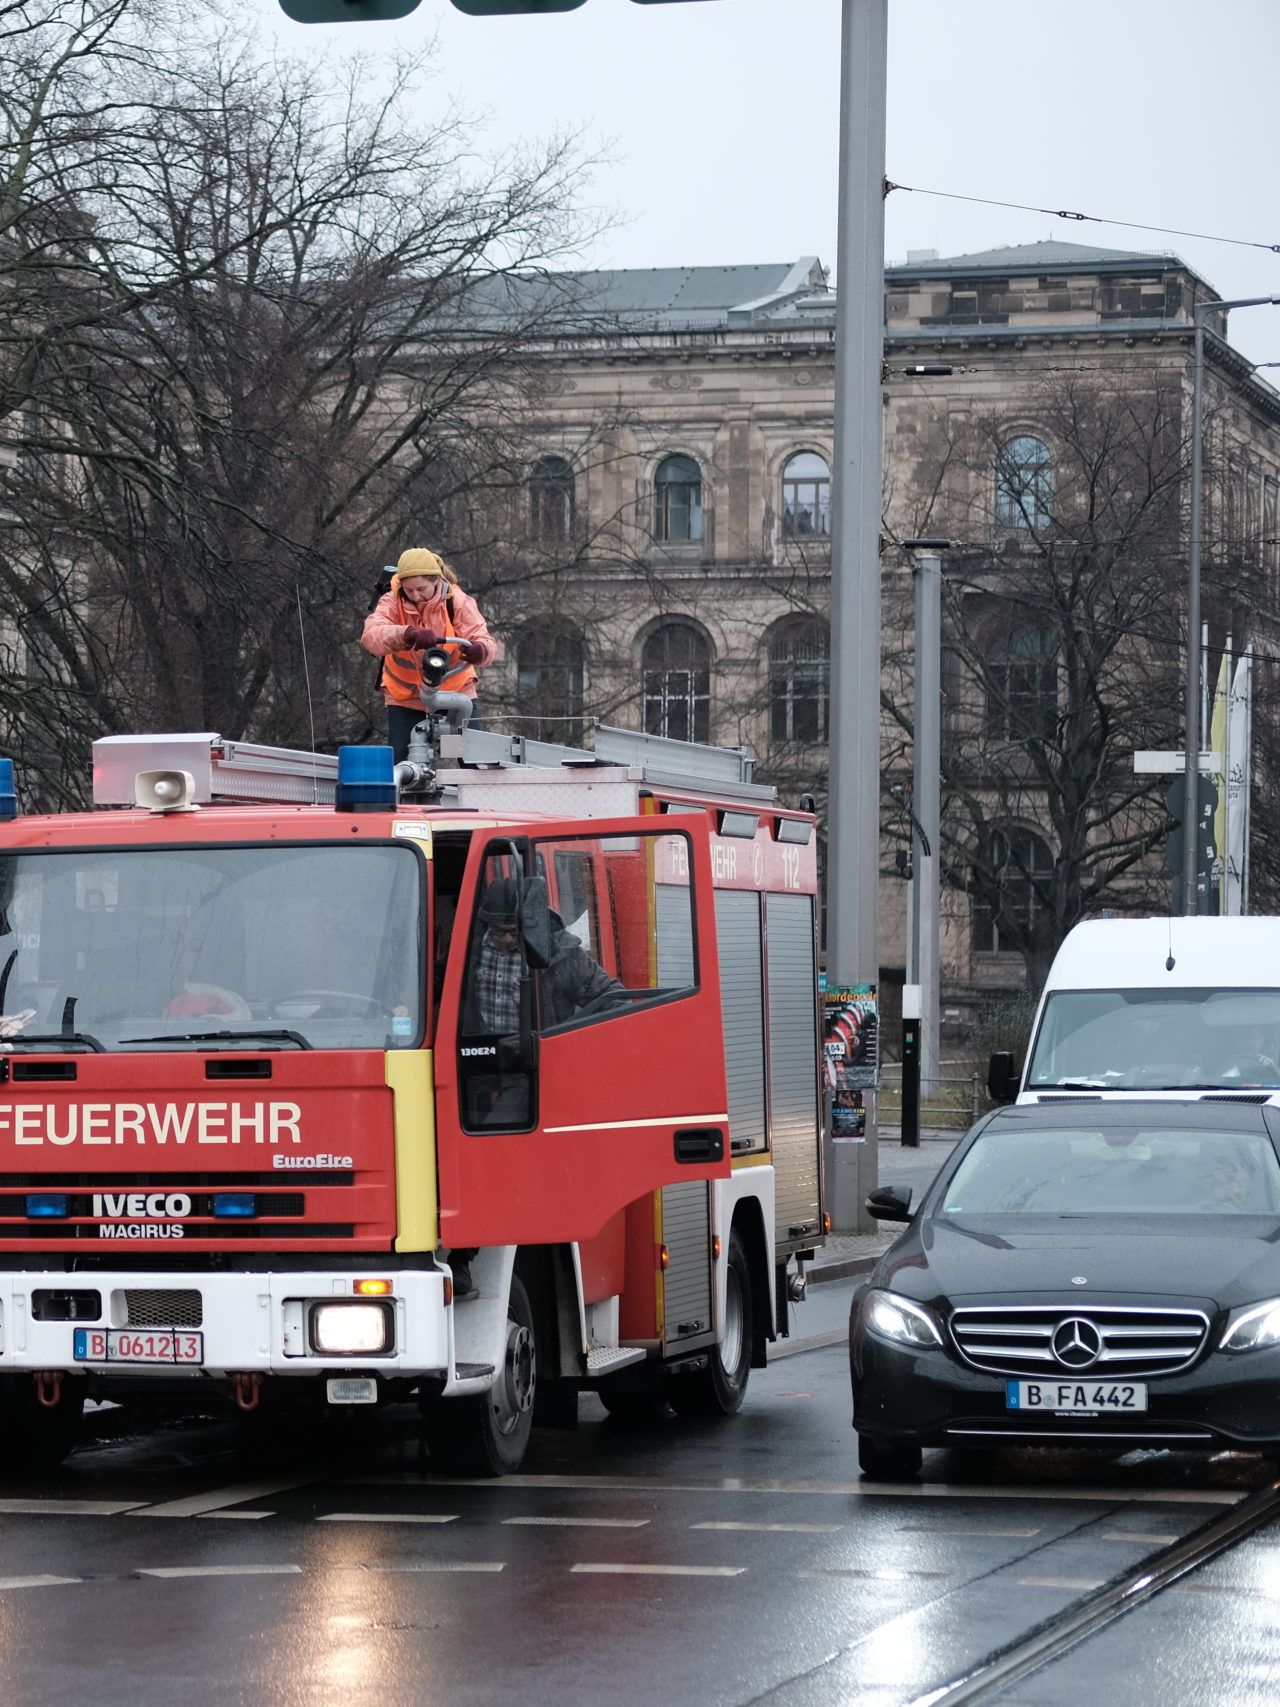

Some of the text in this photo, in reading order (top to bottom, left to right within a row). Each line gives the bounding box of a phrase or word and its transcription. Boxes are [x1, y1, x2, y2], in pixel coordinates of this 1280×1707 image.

[782, 848, 800, 889] 112
[461, 1047, 496, 1056] 130E24
[273, 1154, 353, 1169] EuroFire
[93, 1193, 191, 1218] IVECO
[99, 1224, 184, 1238] MAGIRUS
[91, 1334, 105, 1355] B
[118, 1335, 197, 1358] 061213
[1027, 1385, 1042, 1406] B
[1057, 1386, 1087, 1407] FA
[1092, 1386, 1135, 1407] 442
